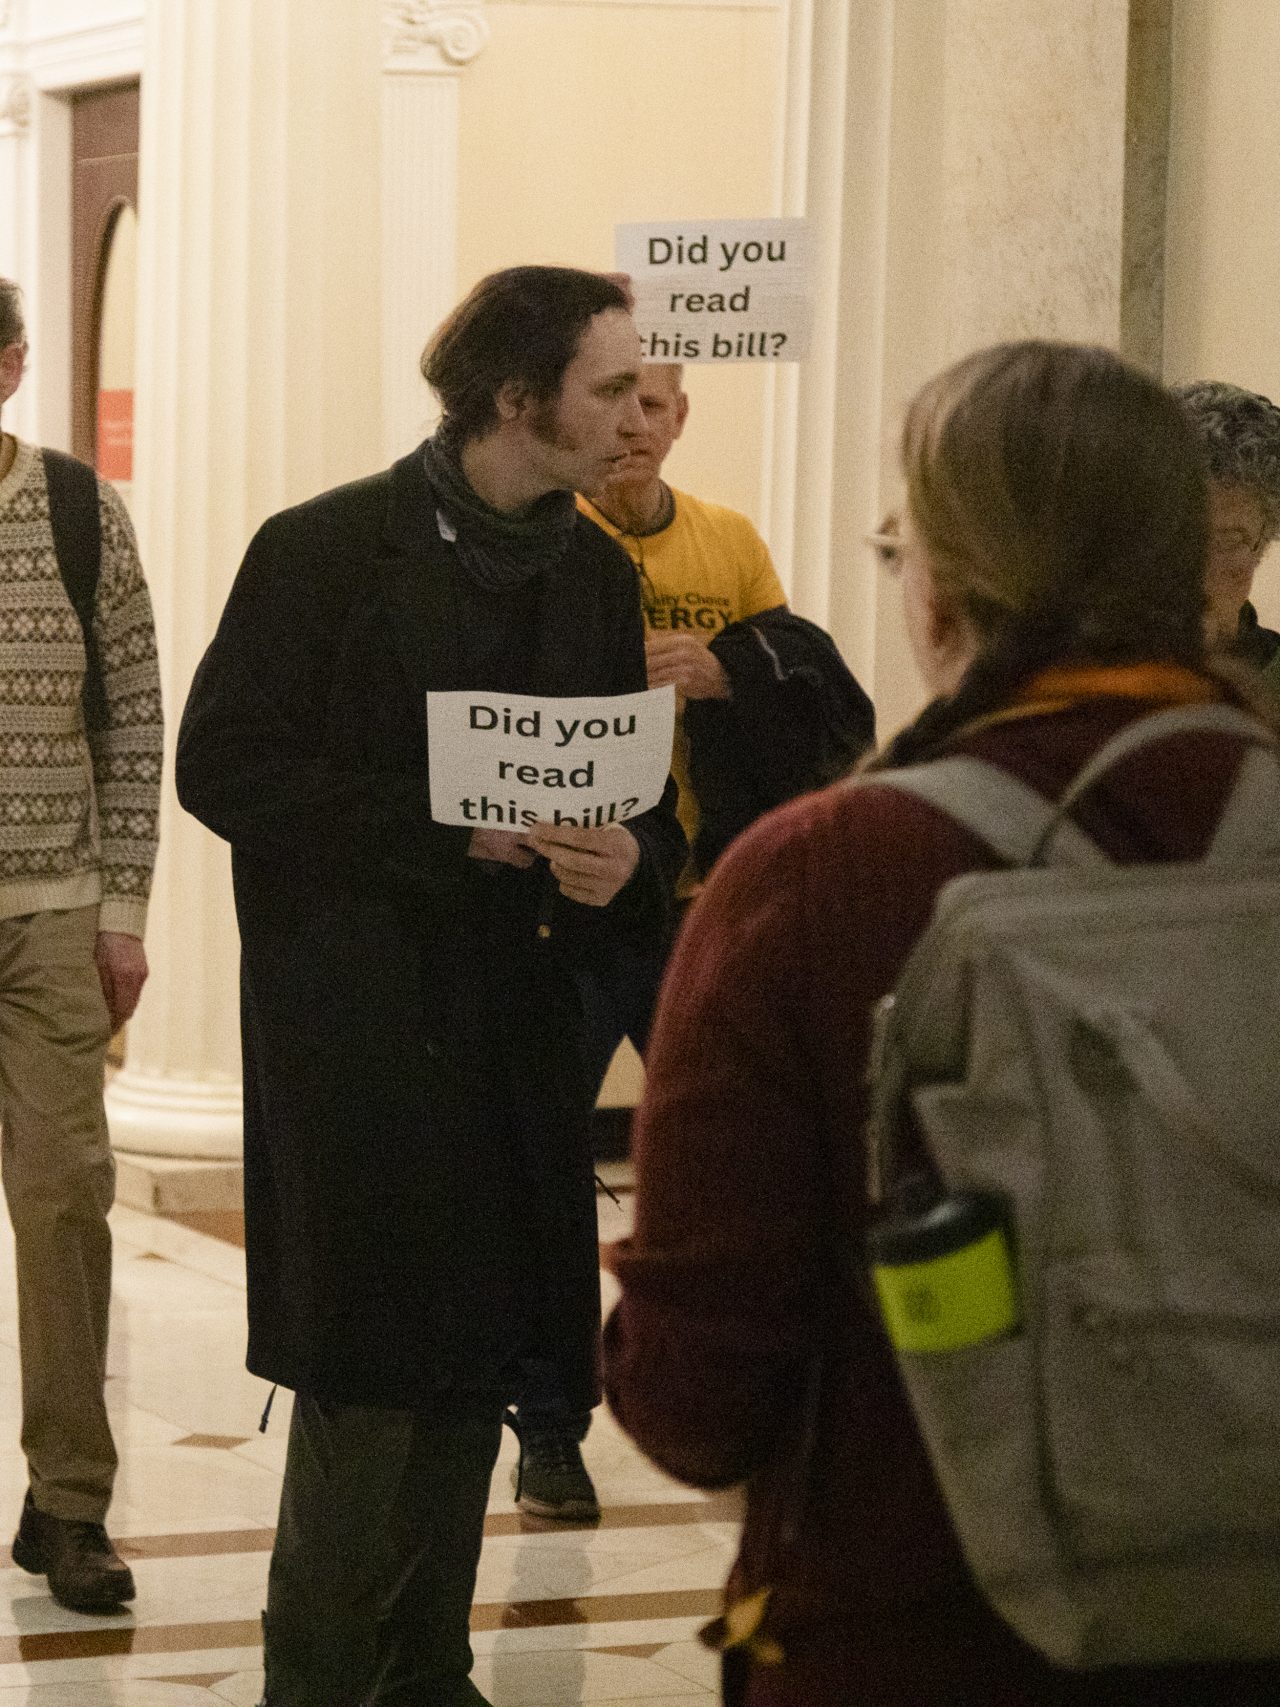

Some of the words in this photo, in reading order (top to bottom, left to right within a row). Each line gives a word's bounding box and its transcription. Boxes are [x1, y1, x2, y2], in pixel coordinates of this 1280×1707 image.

[648, 234, 708, 266] Did
[719, 240, 786, 272] you
[669, 285, 751, 313] read
[711, 331, 788, 359] bill?
[648, 607, 733, 630] ERGY
[470, 705, 541, 738] Did
[554, 715, 637, 748] you
[499, 760, 595, 788] read
[459, 796, 539, 828] this
